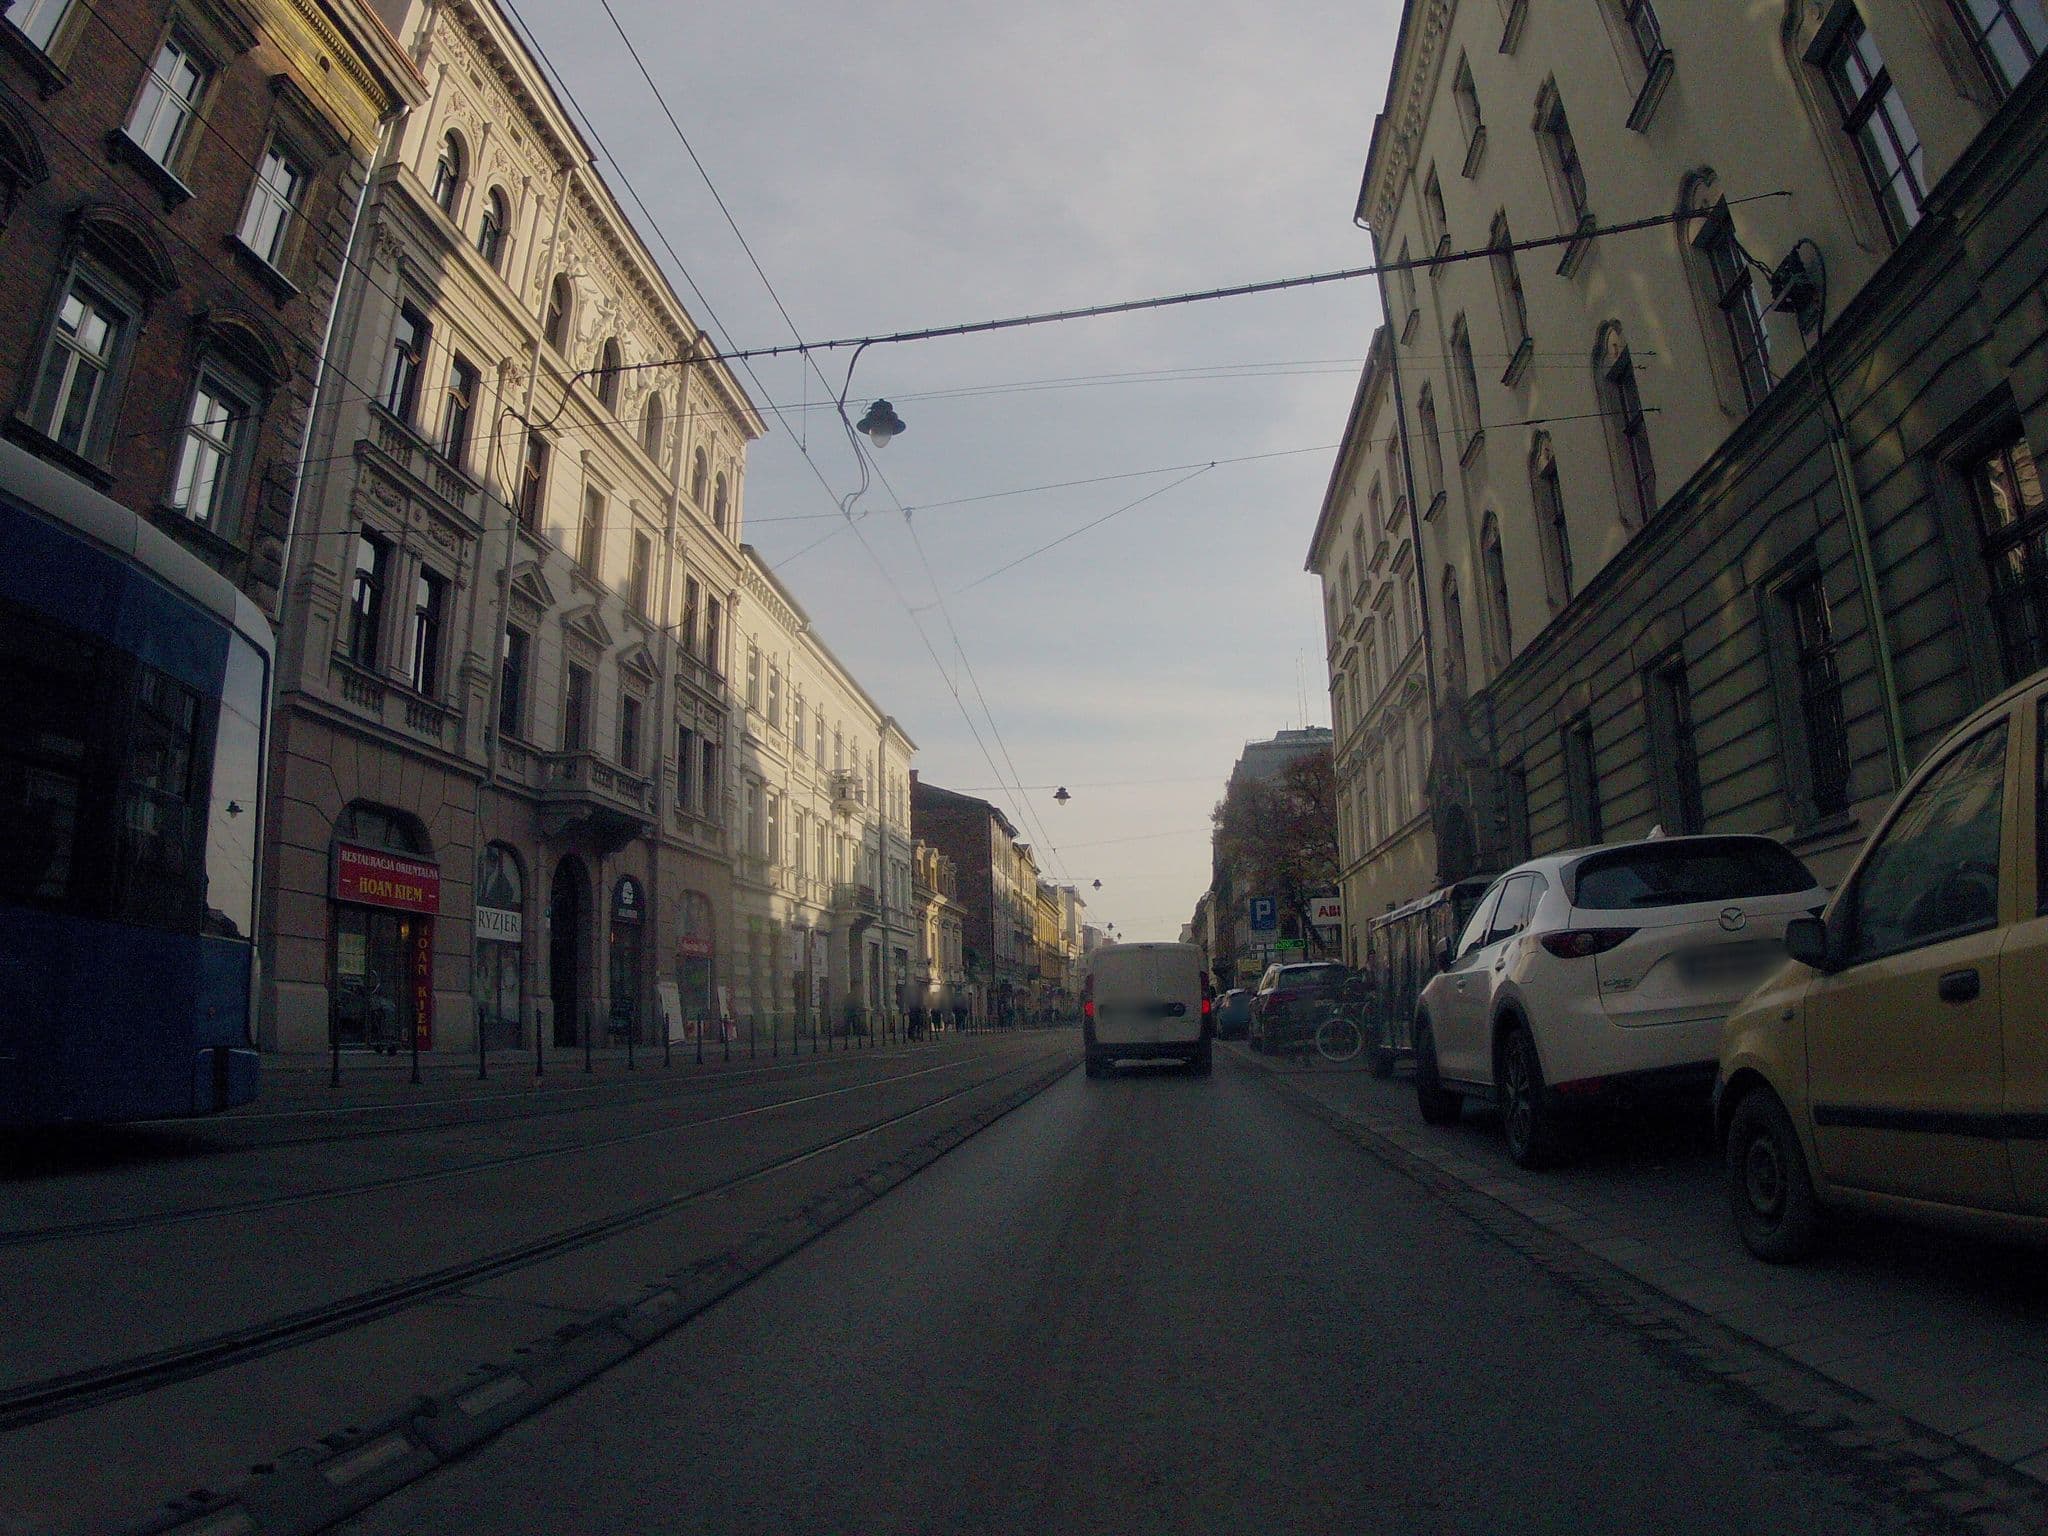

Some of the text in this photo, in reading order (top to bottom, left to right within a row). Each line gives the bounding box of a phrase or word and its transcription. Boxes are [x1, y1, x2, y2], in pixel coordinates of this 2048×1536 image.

[342, 850, 438, 880] RESTAURACJA ORIENTALNA
[359, 877, 422, 902] HOAN KIEM
[1256, 899, 1270, 921] P
